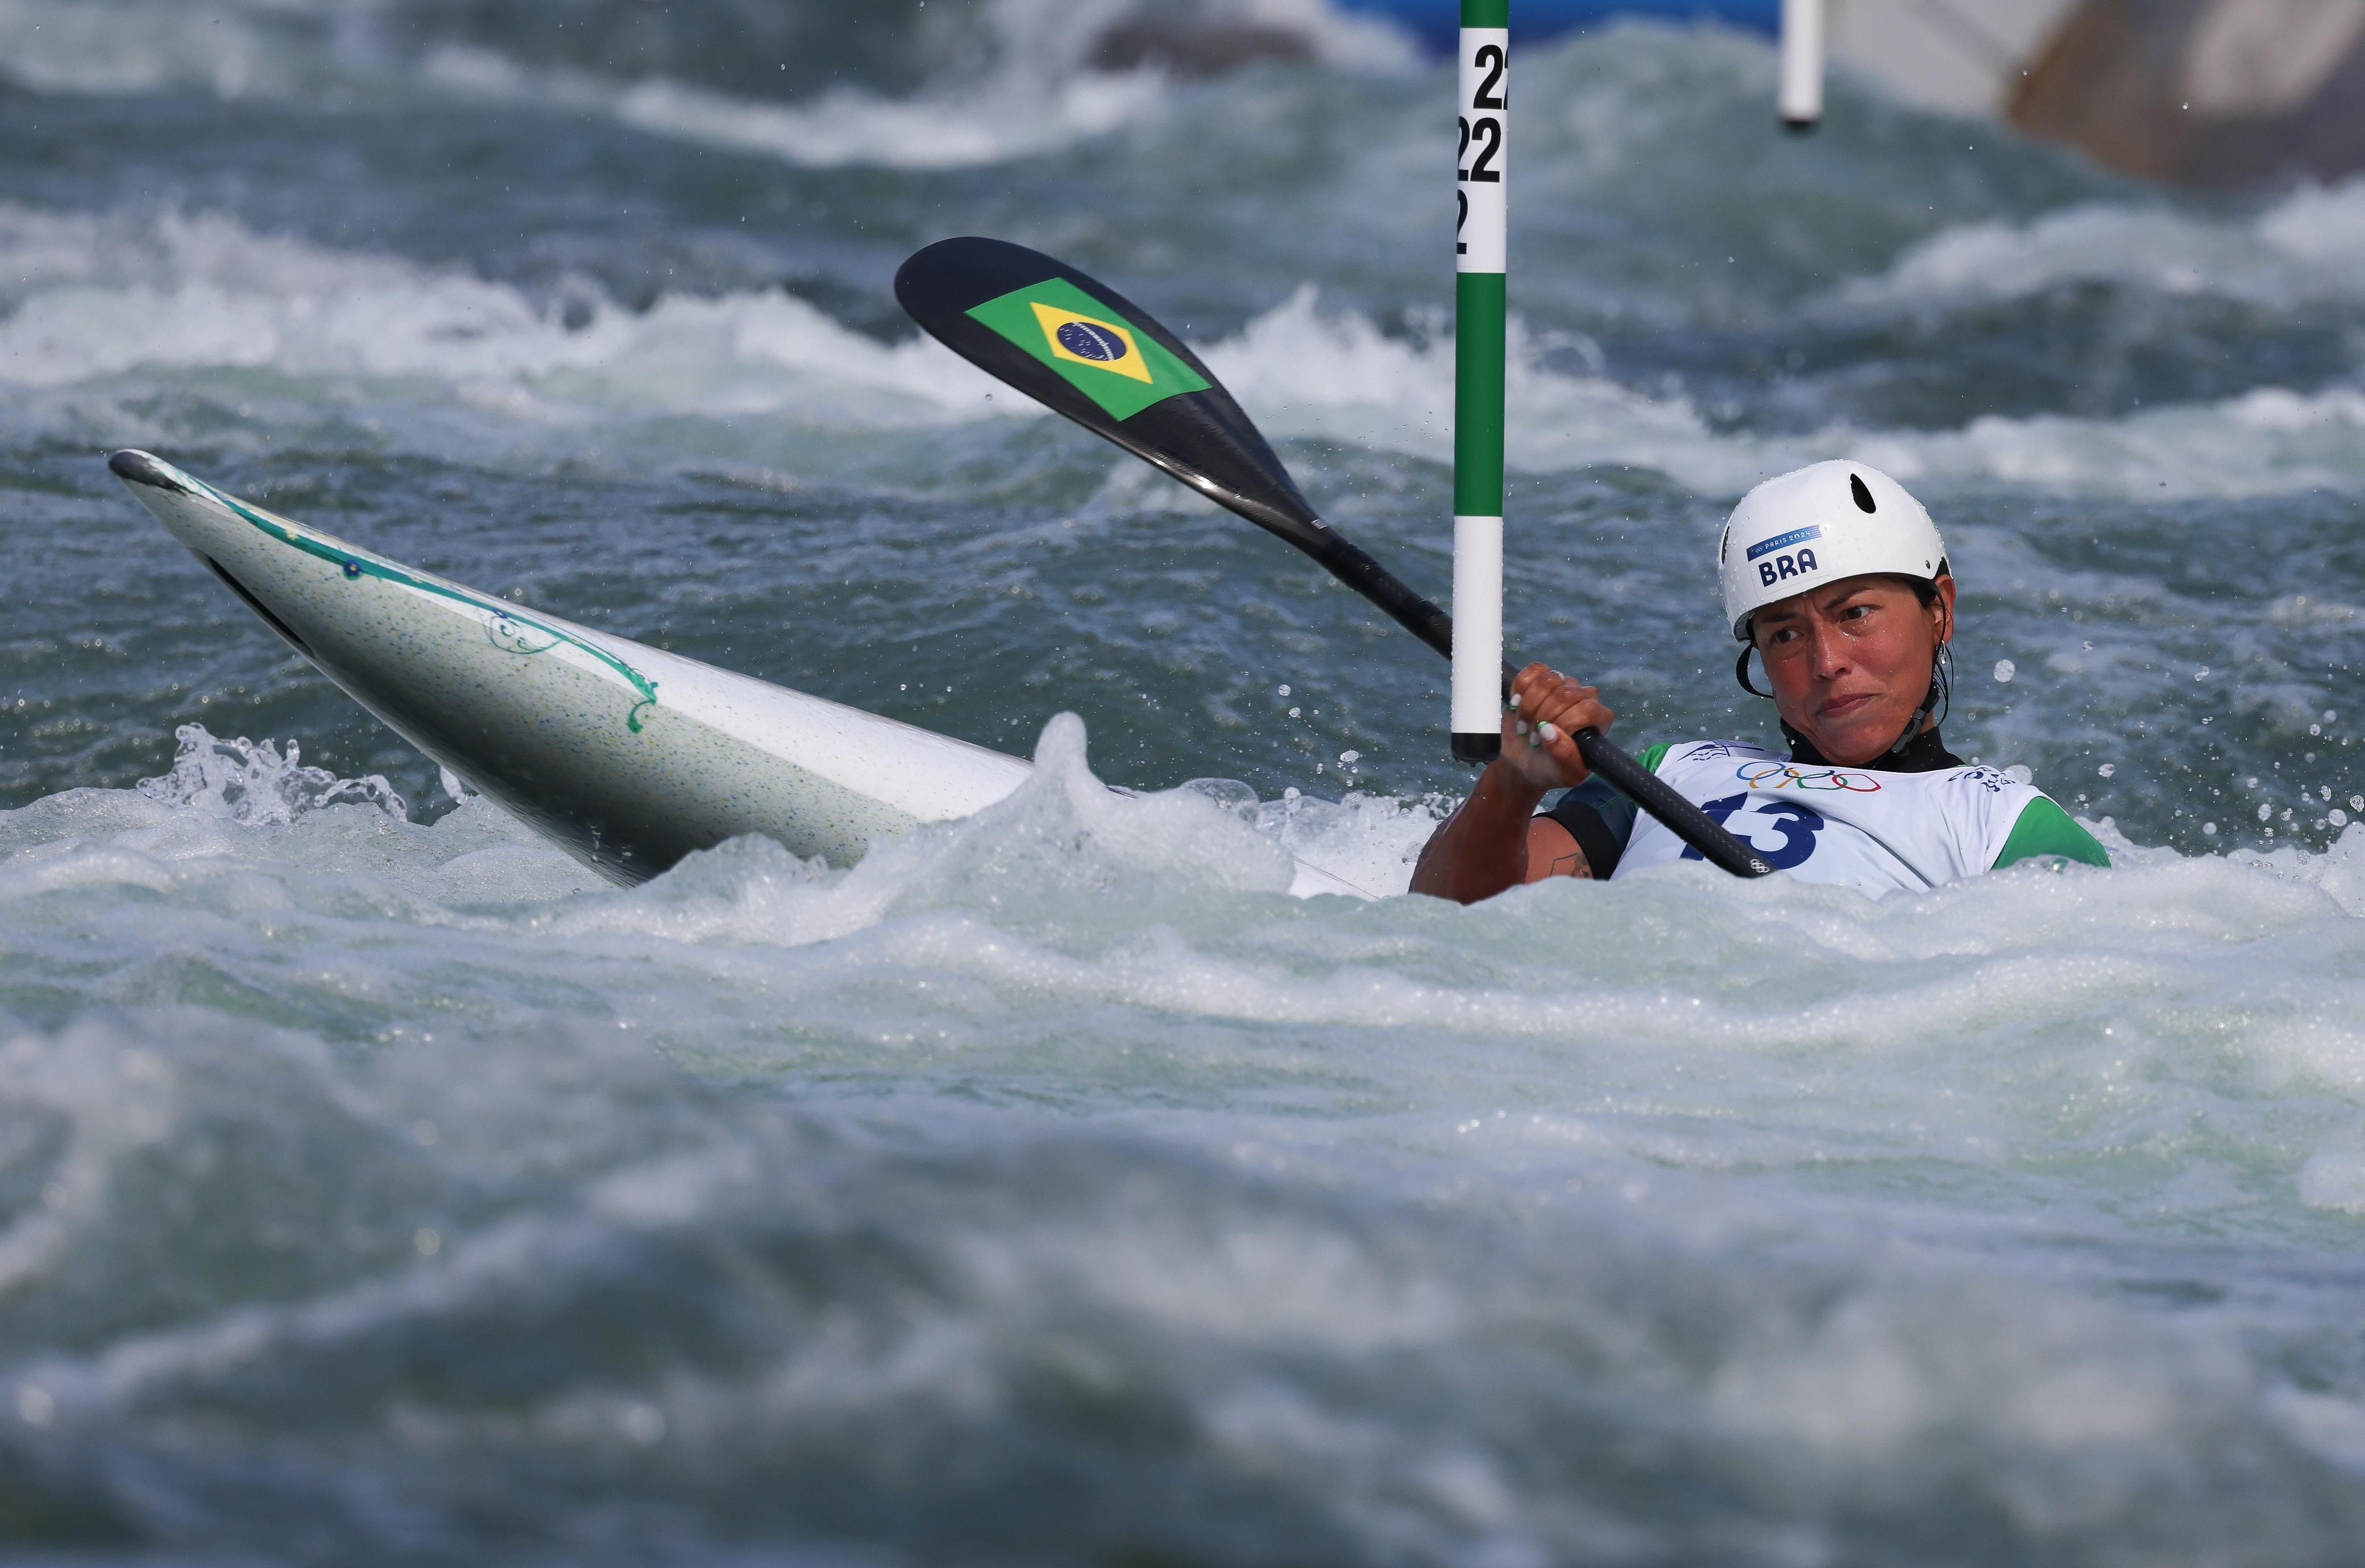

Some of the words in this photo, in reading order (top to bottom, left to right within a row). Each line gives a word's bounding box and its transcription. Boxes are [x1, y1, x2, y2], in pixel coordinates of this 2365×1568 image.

[1458, 116, 1501, 183] 22
[1765, 537, 1787, 549] PARIS
[1789, 531, 1811, 541] 2024
[1758, 548, 1818, 587] BRA
